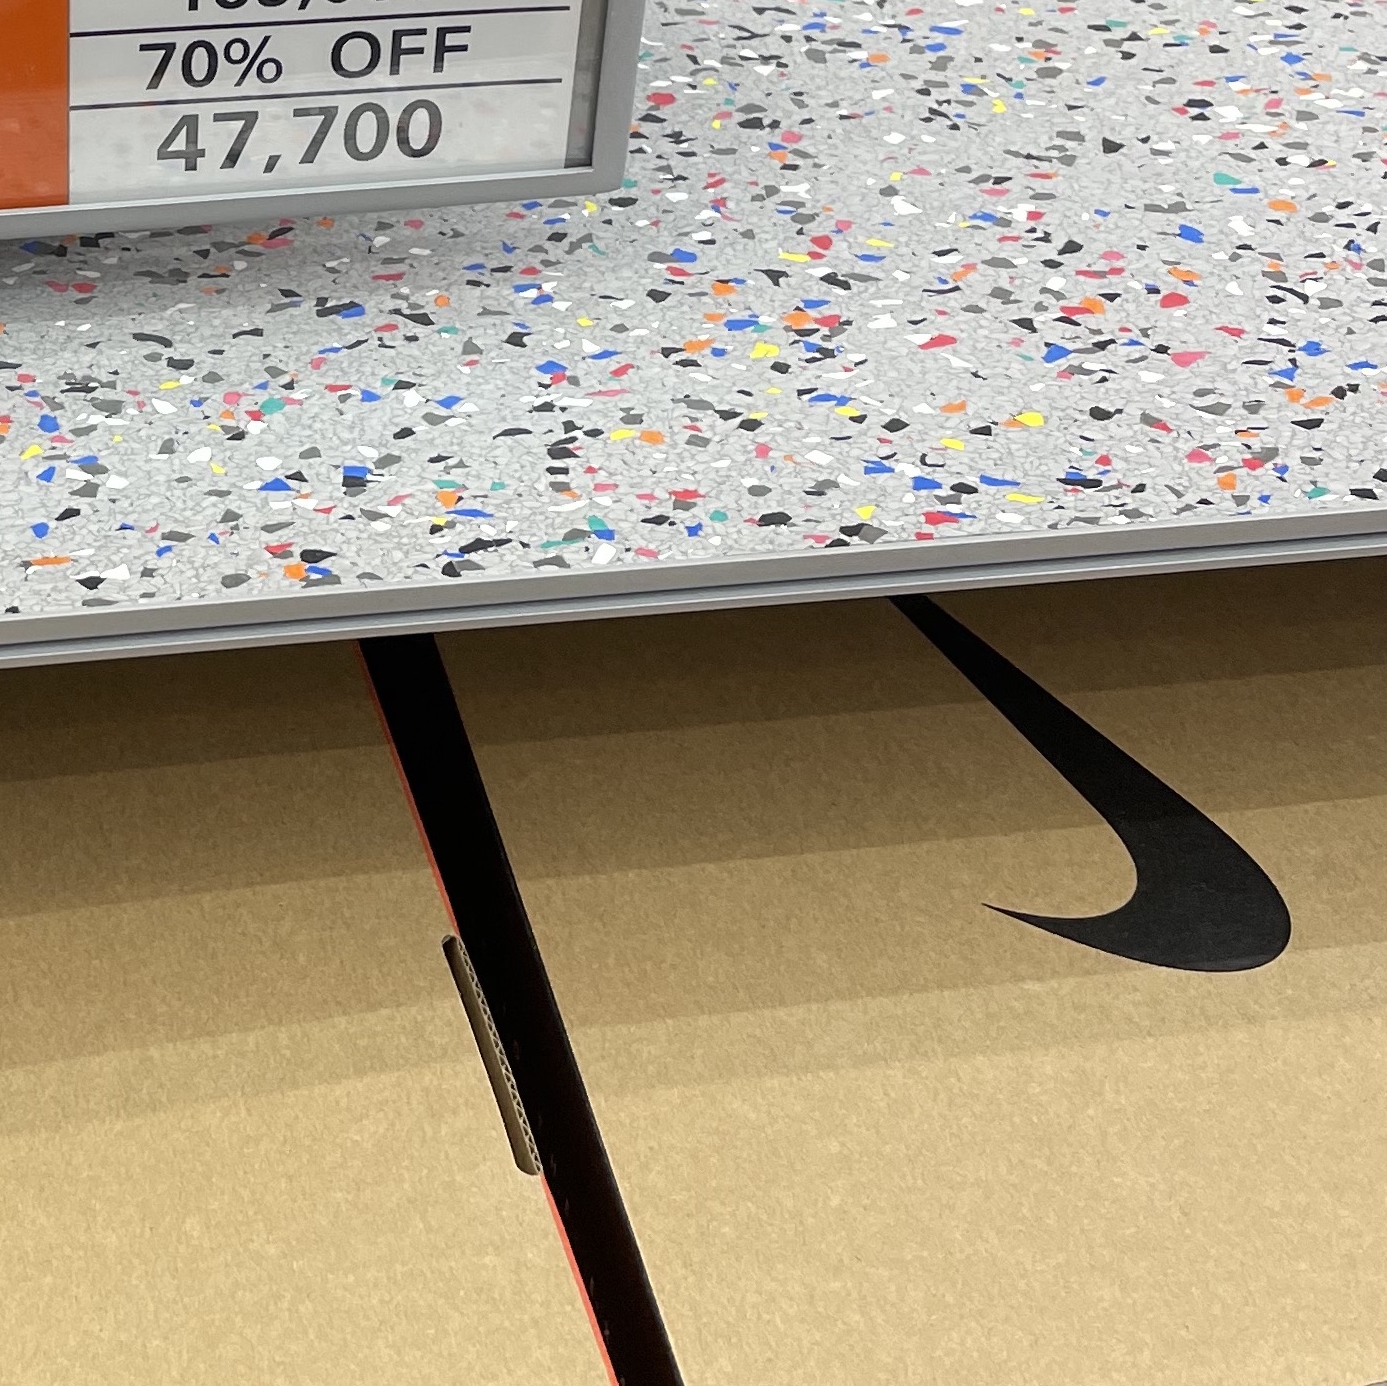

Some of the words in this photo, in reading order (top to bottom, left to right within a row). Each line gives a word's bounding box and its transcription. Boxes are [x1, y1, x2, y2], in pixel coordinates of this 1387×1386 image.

[138, 35, 284, 91] 70%
[329, 25, 473, 79] OFF
[155, 98, 444, 174] 47,700
